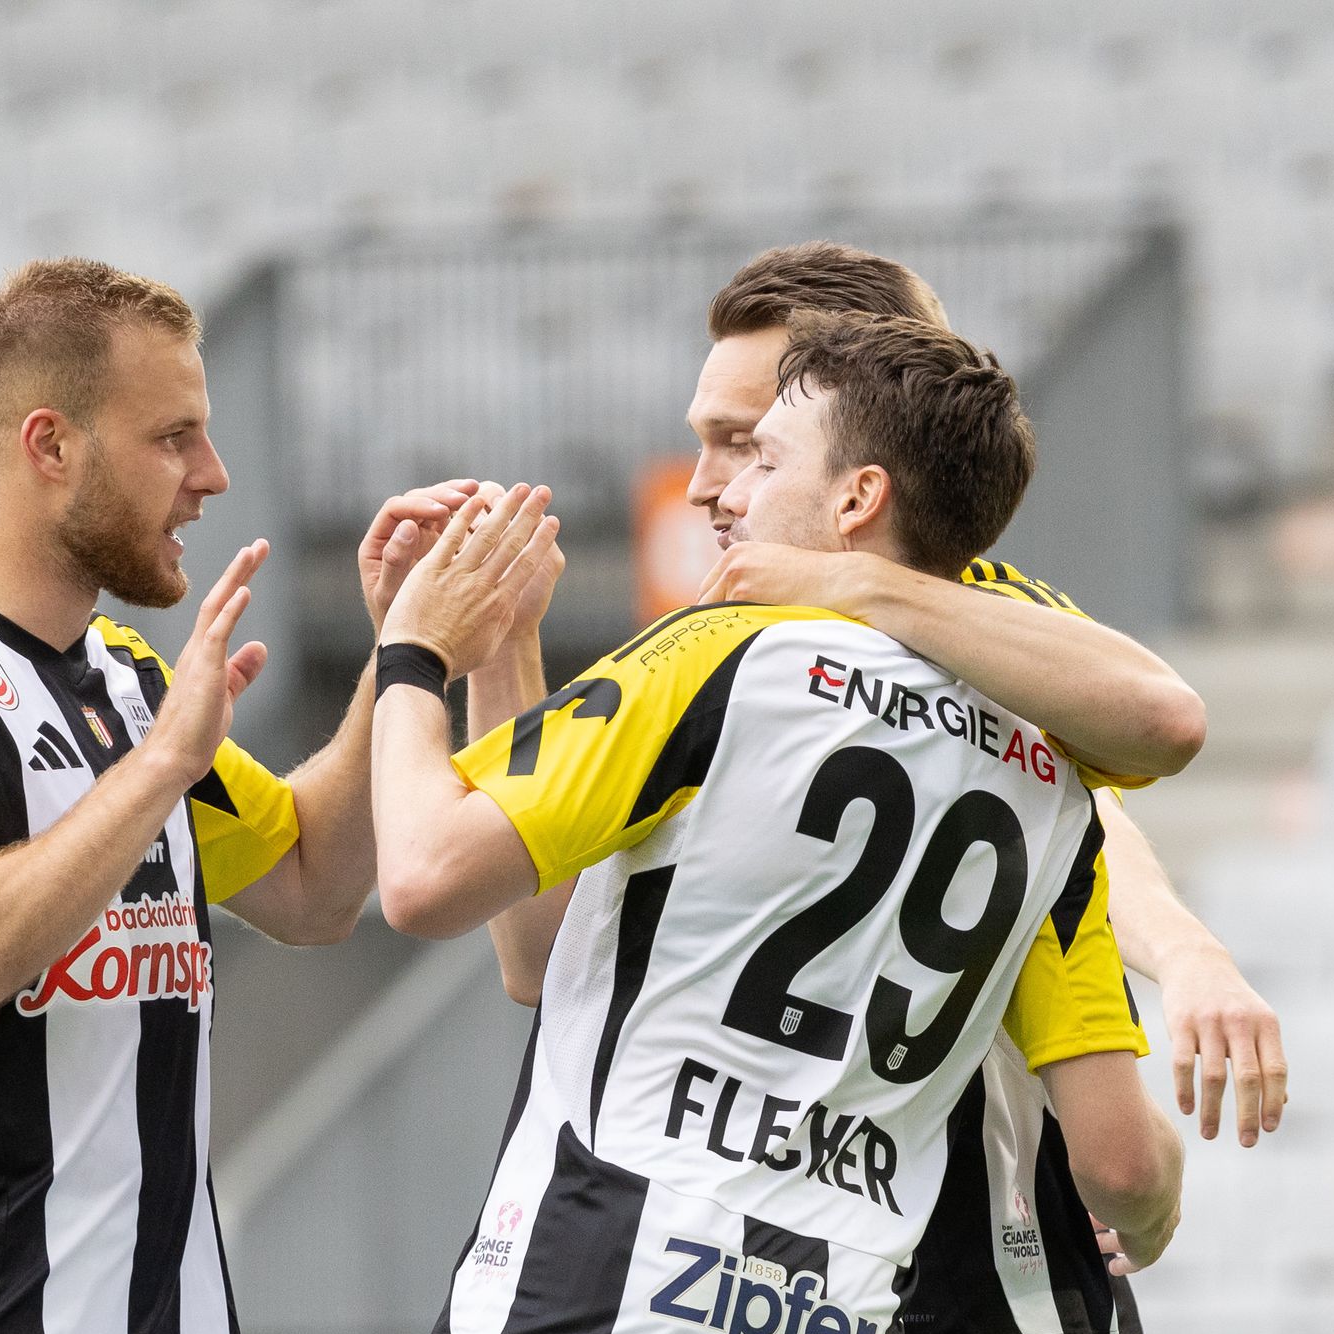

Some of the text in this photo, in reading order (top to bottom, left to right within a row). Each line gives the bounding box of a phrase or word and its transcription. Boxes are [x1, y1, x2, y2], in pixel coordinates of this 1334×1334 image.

[139, 841, 165, 864] WT
[720, 745, 1029, 1086] 29
[19, 925, 209, 1012] Kornsp
[1002, 1229, 1038, 1246] CHANGE
[1012, 1244, 1040, 1259] WORLD
[748, 1261, 783, 1282] 1858
